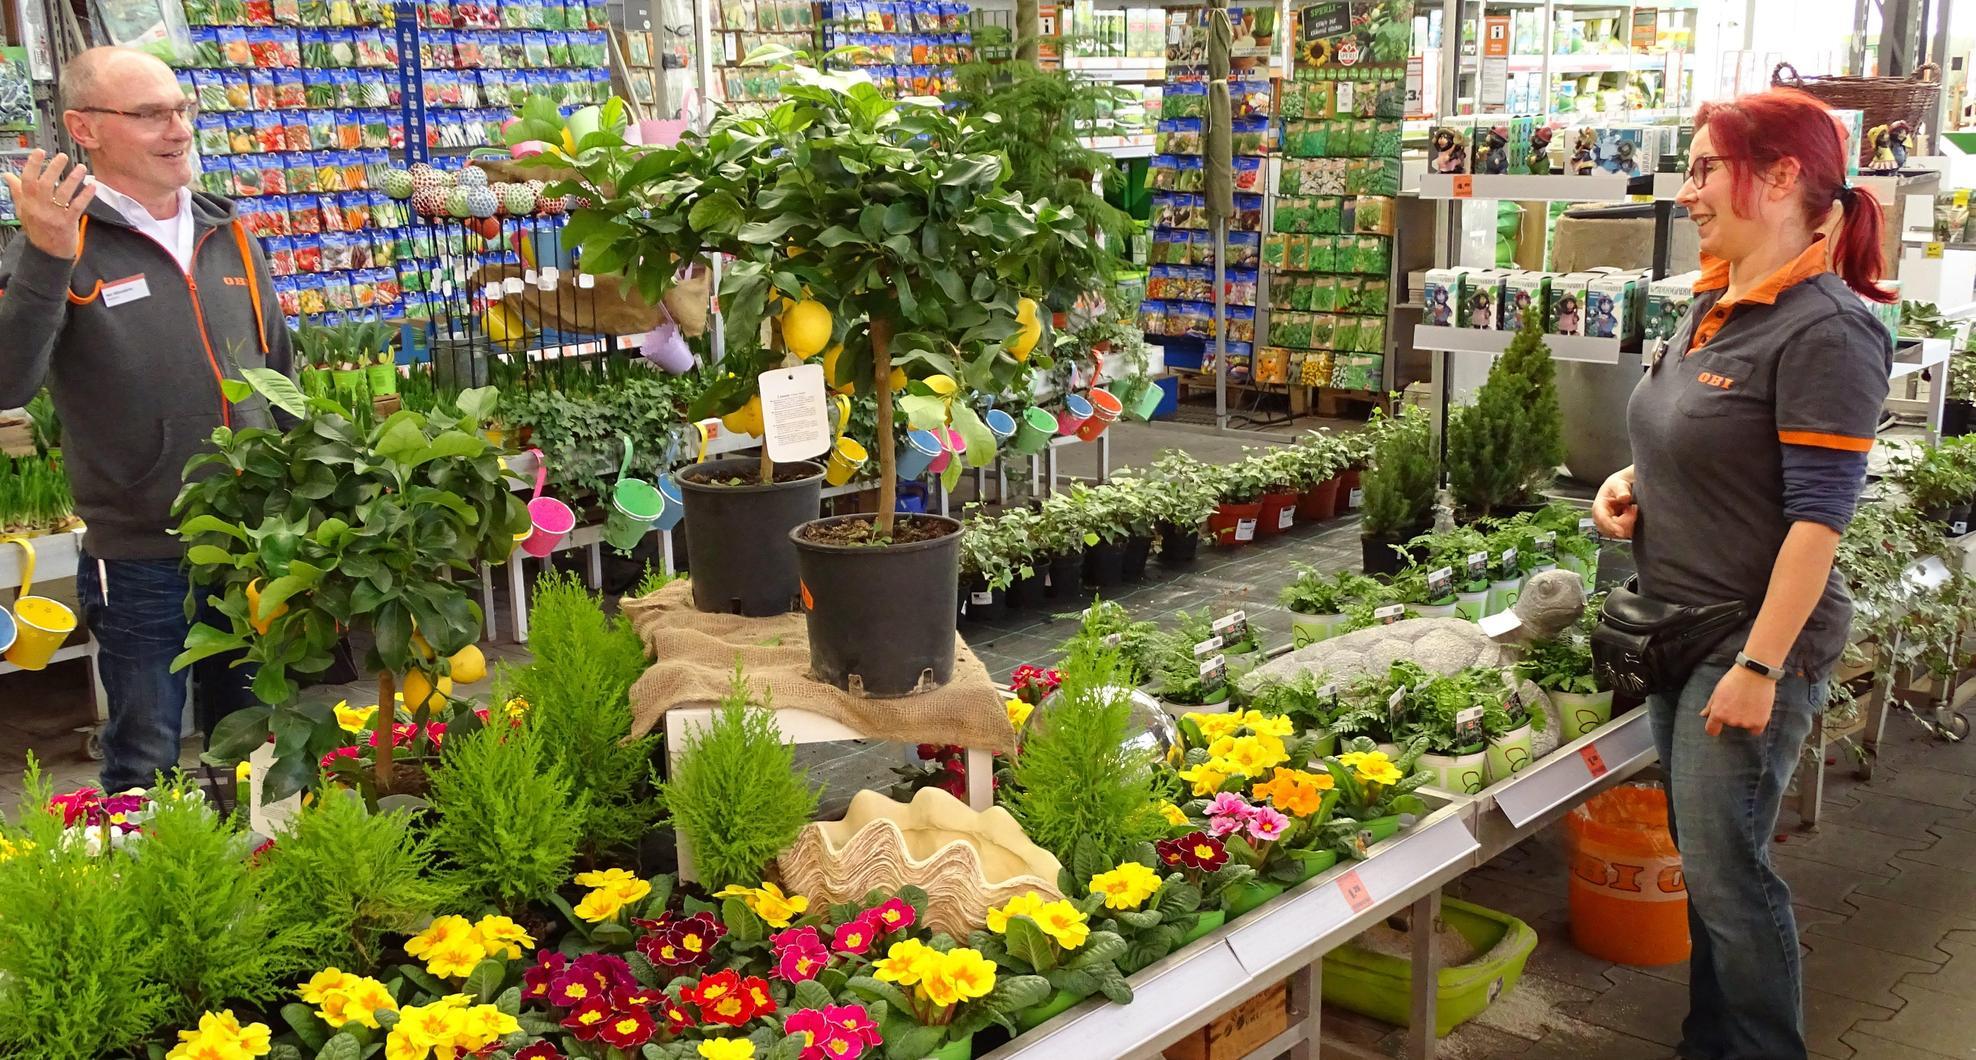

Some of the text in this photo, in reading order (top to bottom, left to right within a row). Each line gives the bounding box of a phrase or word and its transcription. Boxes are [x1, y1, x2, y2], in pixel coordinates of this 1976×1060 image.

[1310, 4, 1336, 18] SPERLI
[223, 276, 249, 286] OB
[1697, 372, 1735, 390] OBI
[1573, 852, 1645, 893] BI
